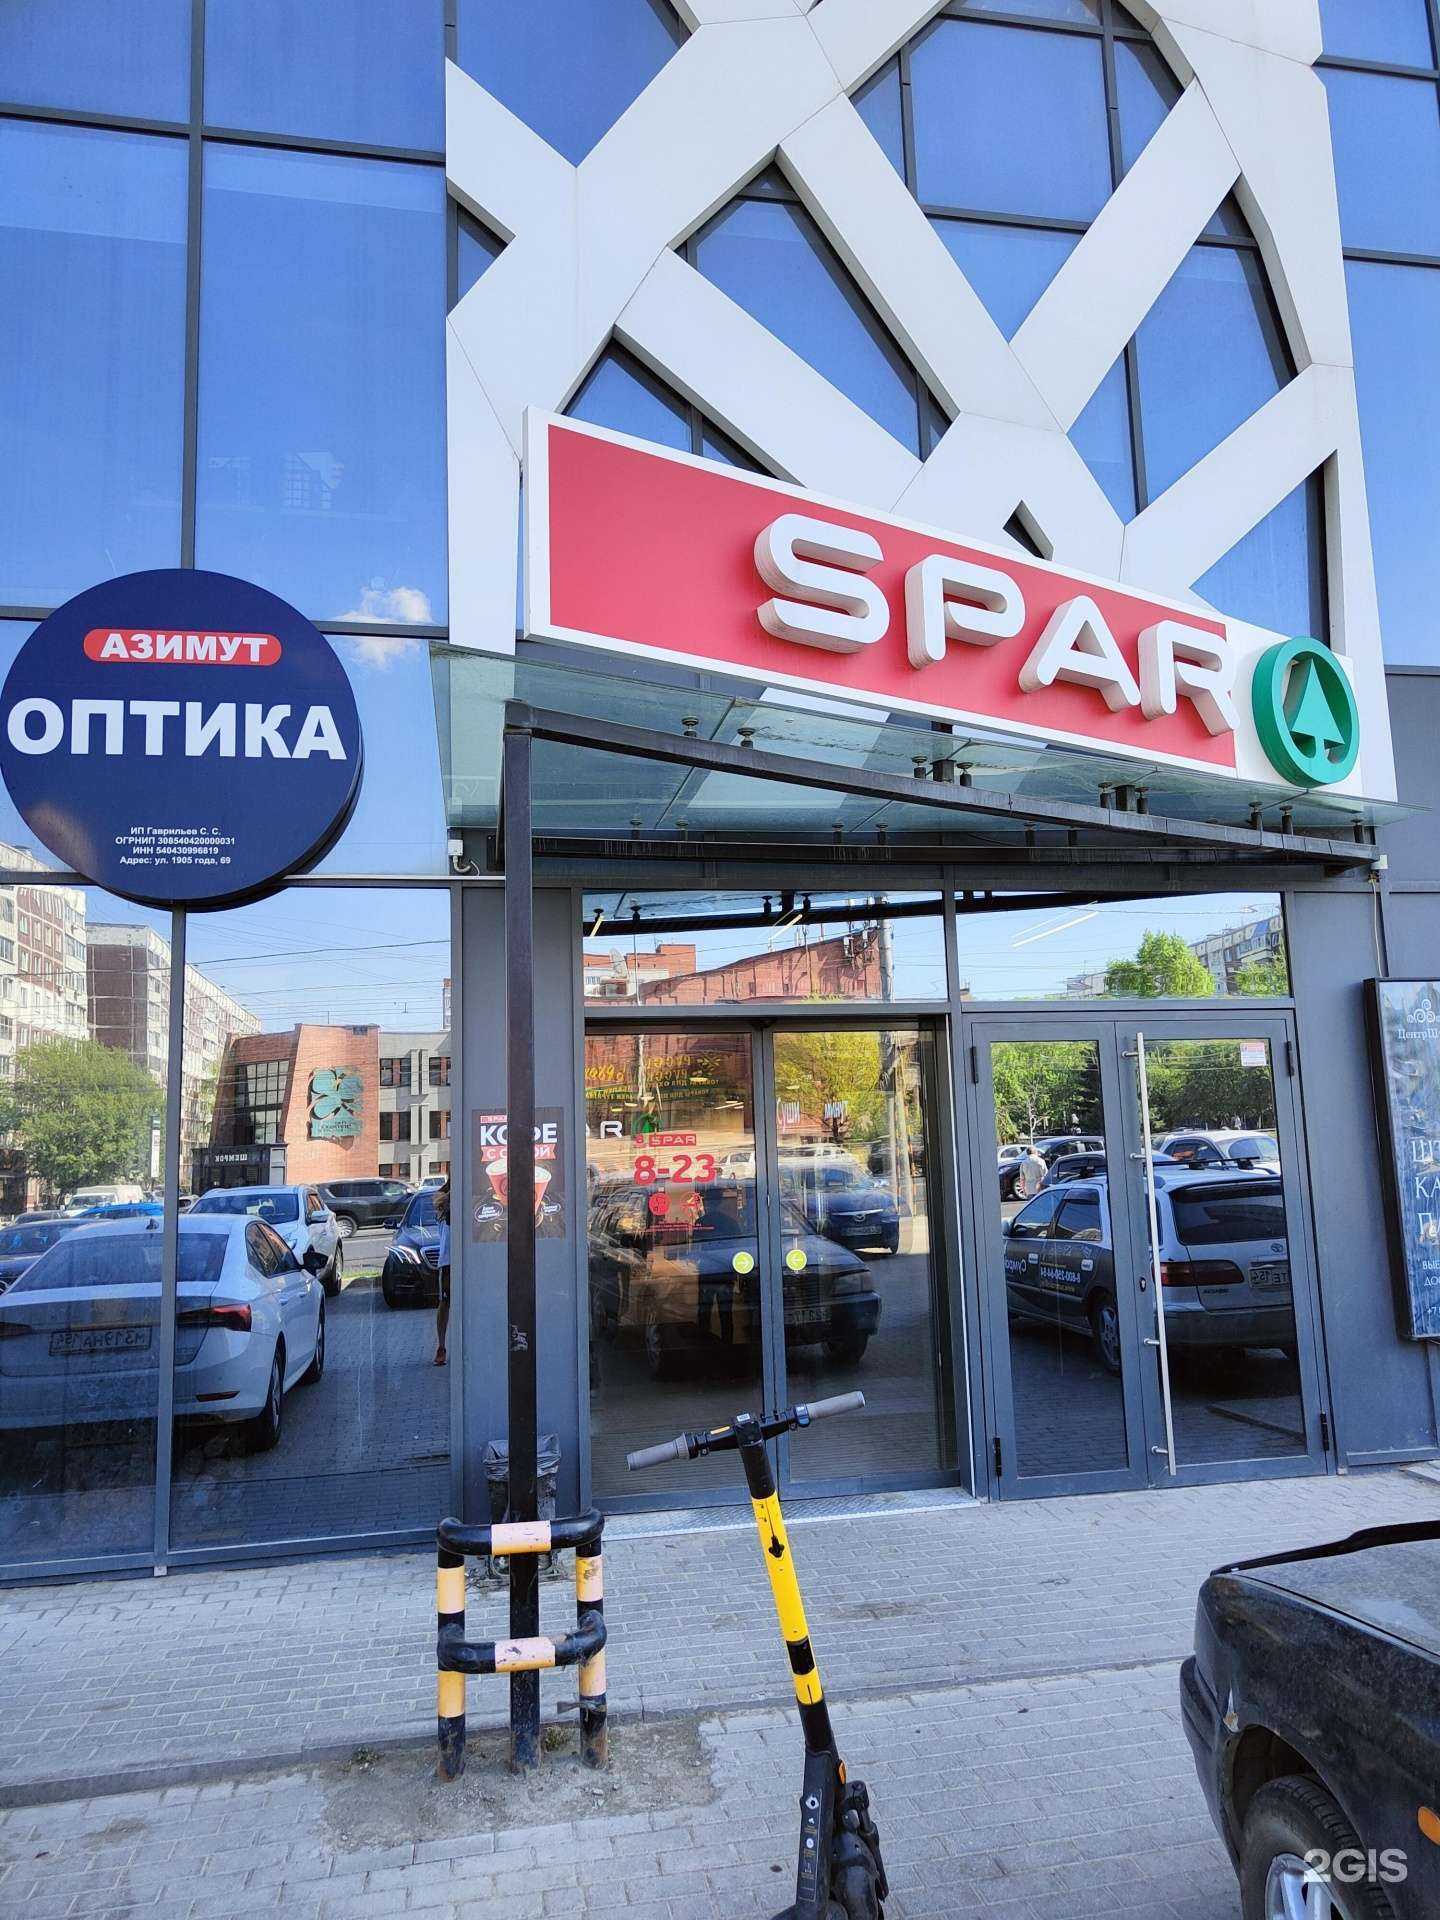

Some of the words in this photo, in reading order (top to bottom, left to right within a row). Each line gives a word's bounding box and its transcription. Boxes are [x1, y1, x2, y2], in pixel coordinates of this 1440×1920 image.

[753, 513, 1240, 736] SPAR
[100, 633, 268, 662] АЗИМУТ
[7, 697, 347, 760] ОПТИКА
[130, 827, 145, 835] ИП
[147, 827, 198, 836] Гаврильев
[200, 827, 209, 835] С.
[115, 837, 155, 845] ОГРНИП
[157, 837, 235, 845] 308540420000031
[133, 847, 154, 855] ИНН
[120, 856, 152, 866] Адрес:
[155, 858, 168, 866] ул.
[195, 858, 218, 866] года,
[651, 1136, 695, 1145] SPAR
[634, 1154, 717, 1186] 8-23
